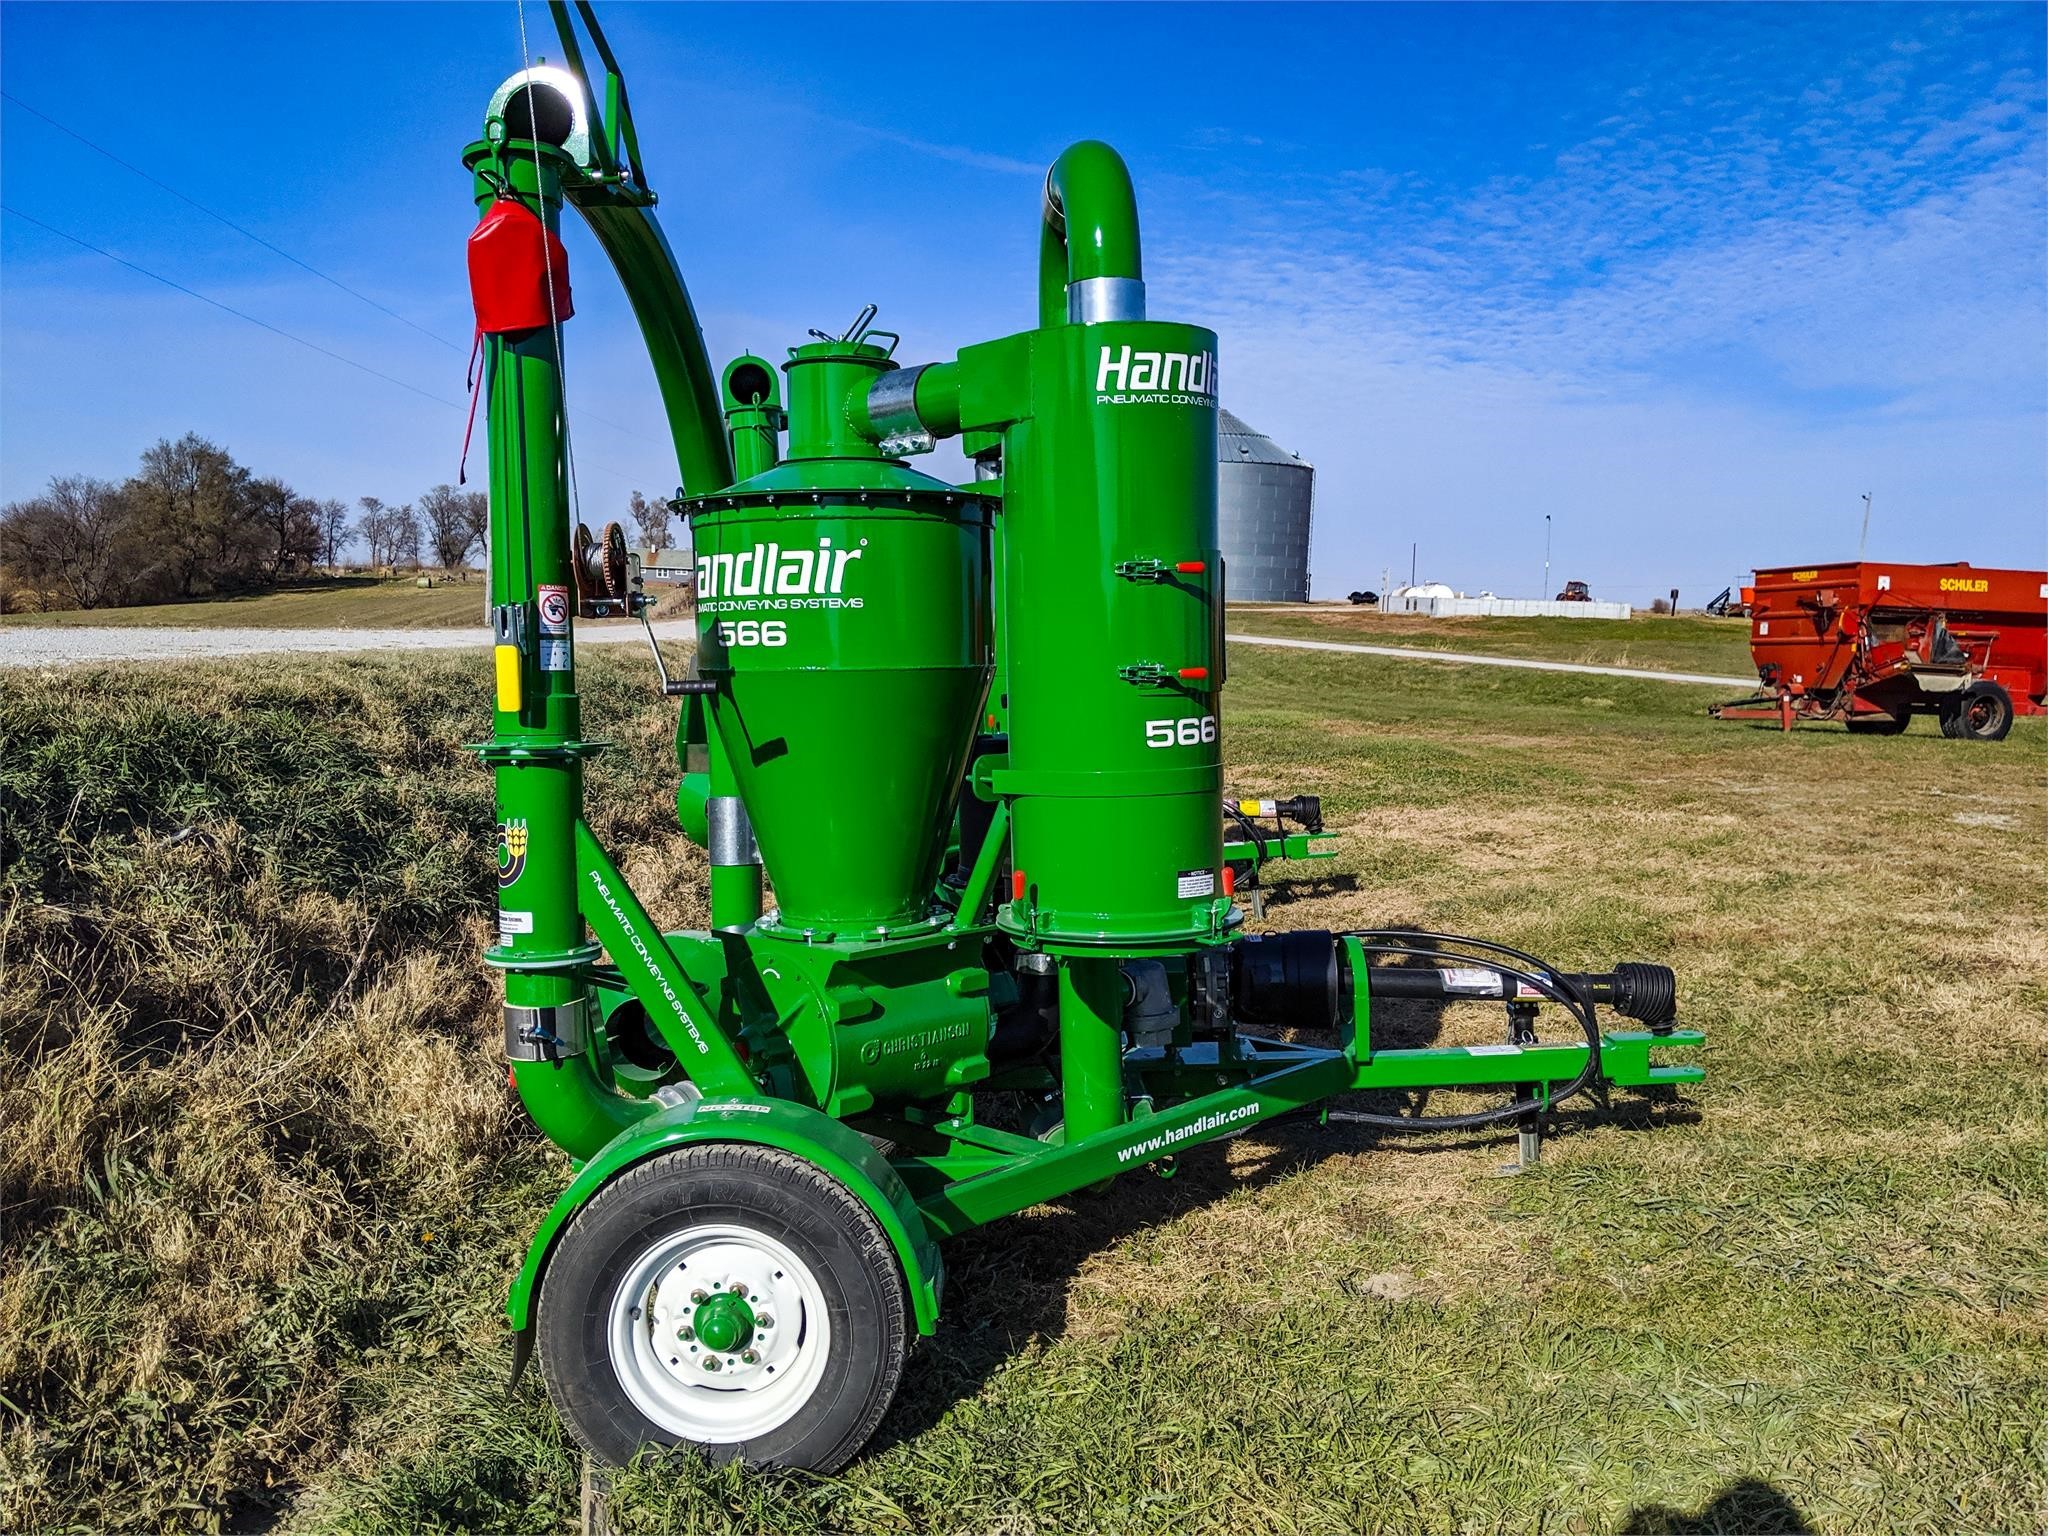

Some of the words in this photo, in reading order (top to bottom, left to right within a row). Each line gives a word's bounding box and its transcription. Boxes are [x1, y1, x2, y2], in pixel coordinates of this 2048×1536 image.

[1096, 394, 1169, 405] PNEUMATIC
[695, 538, 862, 599] andlair
[1940, 578, 1988, 592] SCHULER
[719, 598, 788, 612] CONVEYING
[790, 597, 864, 609] SYSTEMS
[717, 620, 788, 647] 566
[1145, 715, 1216, 748] 566
[589, 870, 635, 936] PNEUMATIC
[671, 999, 710, 1055] SYSTEMS
[883, 1022, 971, 1056] CHRISTIANSON
[1117, 1102, 1260, 1162] www.handlair.com
